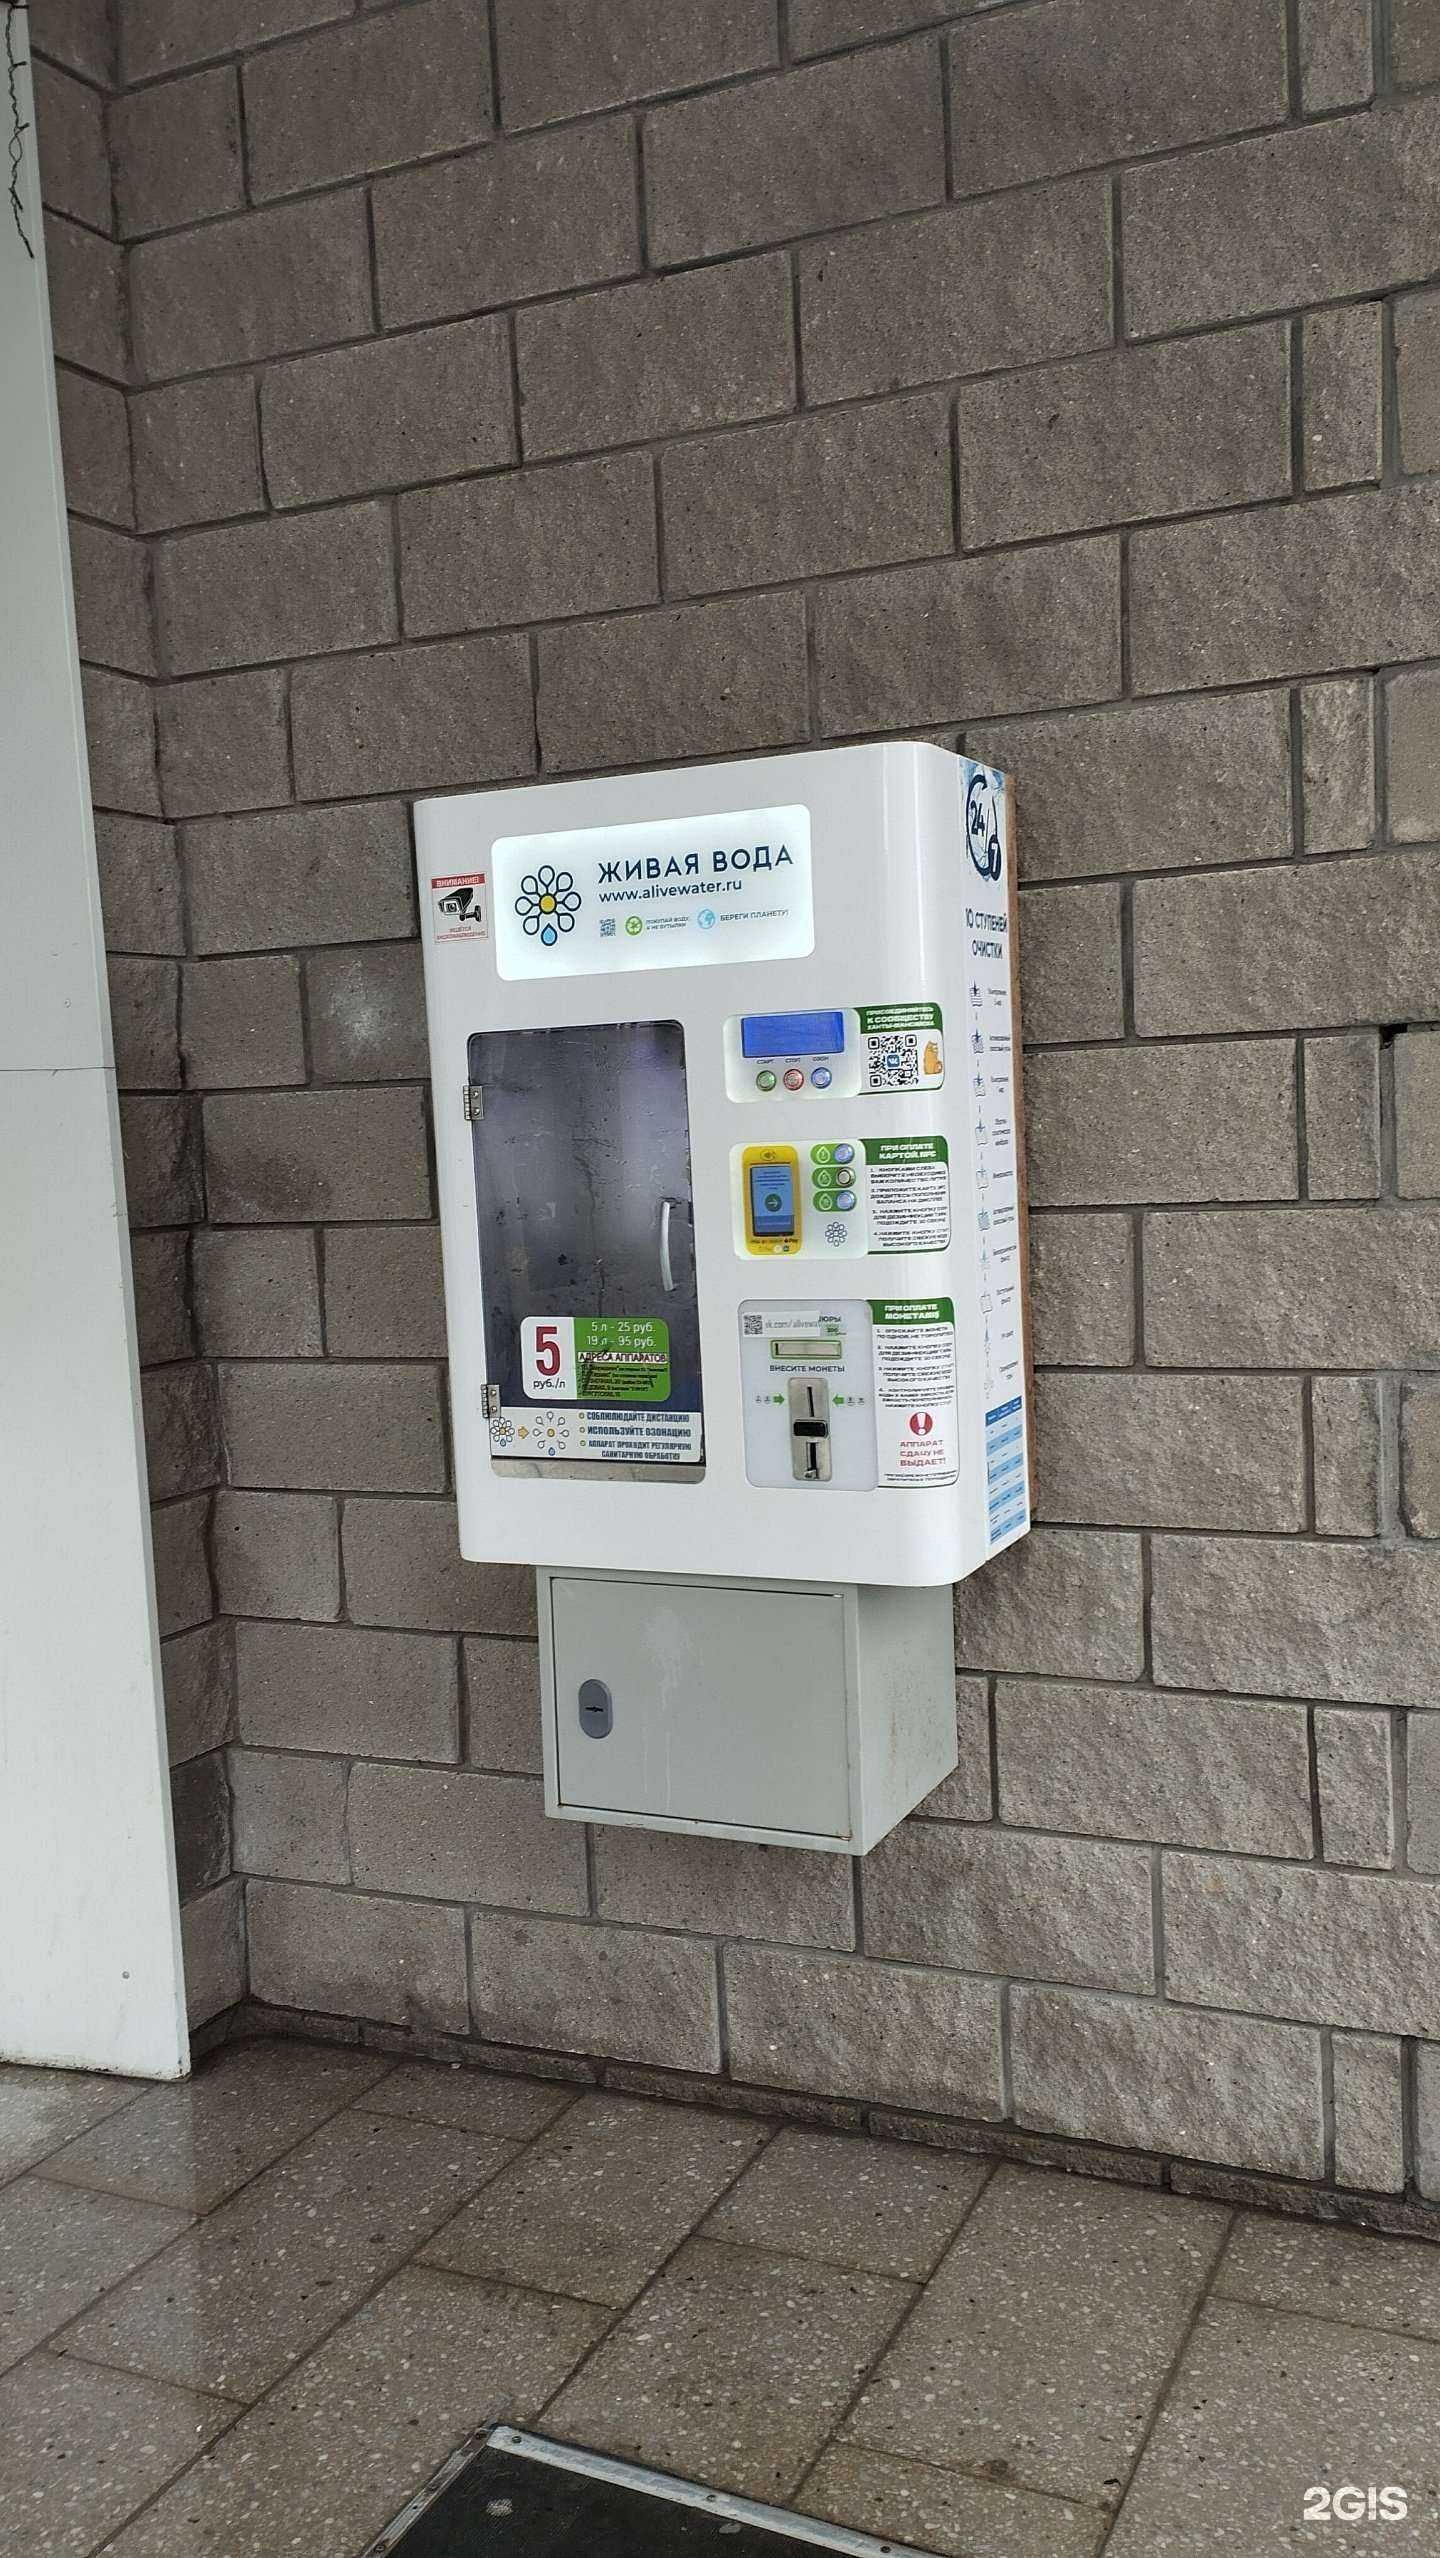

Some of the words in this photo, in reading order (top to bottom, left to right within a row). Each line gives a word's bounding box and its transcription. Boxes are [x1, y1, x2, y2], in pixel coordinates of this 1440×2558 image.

[970, 800, 985, 837] 24
[598, 853, 700, 884] ЖИВАЯ
[713, 844, 793, 872] ВОДА
[599, 880, 742, 903] www.alivewater.ru
[720, 912, 748, 922] БЕРЕГИ
[972, 939, 1003, 959] ОЧИСТКИ
[899, 1143, 934, 1151] ОПЛАТЕ
[591, 1321, 598, 1331] 5
[601, 1323, 607, 1331] л
[617, 1321, 630, 1332] 25
[633, 1321, 656, 1334] руб.
[586, 1335, 598, 1345] 19
[618, 1335, 631, 1346] 95
[634, 1335, 656, 1349] руб.
[536, 1326, 560, 1376] 5
[533, 1378, 566, 1390] руб./л
[587, 1425, 644, 1436] ИСПОЛЬЗУЙТЕ
[645, 1427, 691, 1438] ОЗОНАЦИЮ
[588, 1440, 616, 1448] АППАРАТ
[900, 1439, 943, 1447] АППАРАТ
